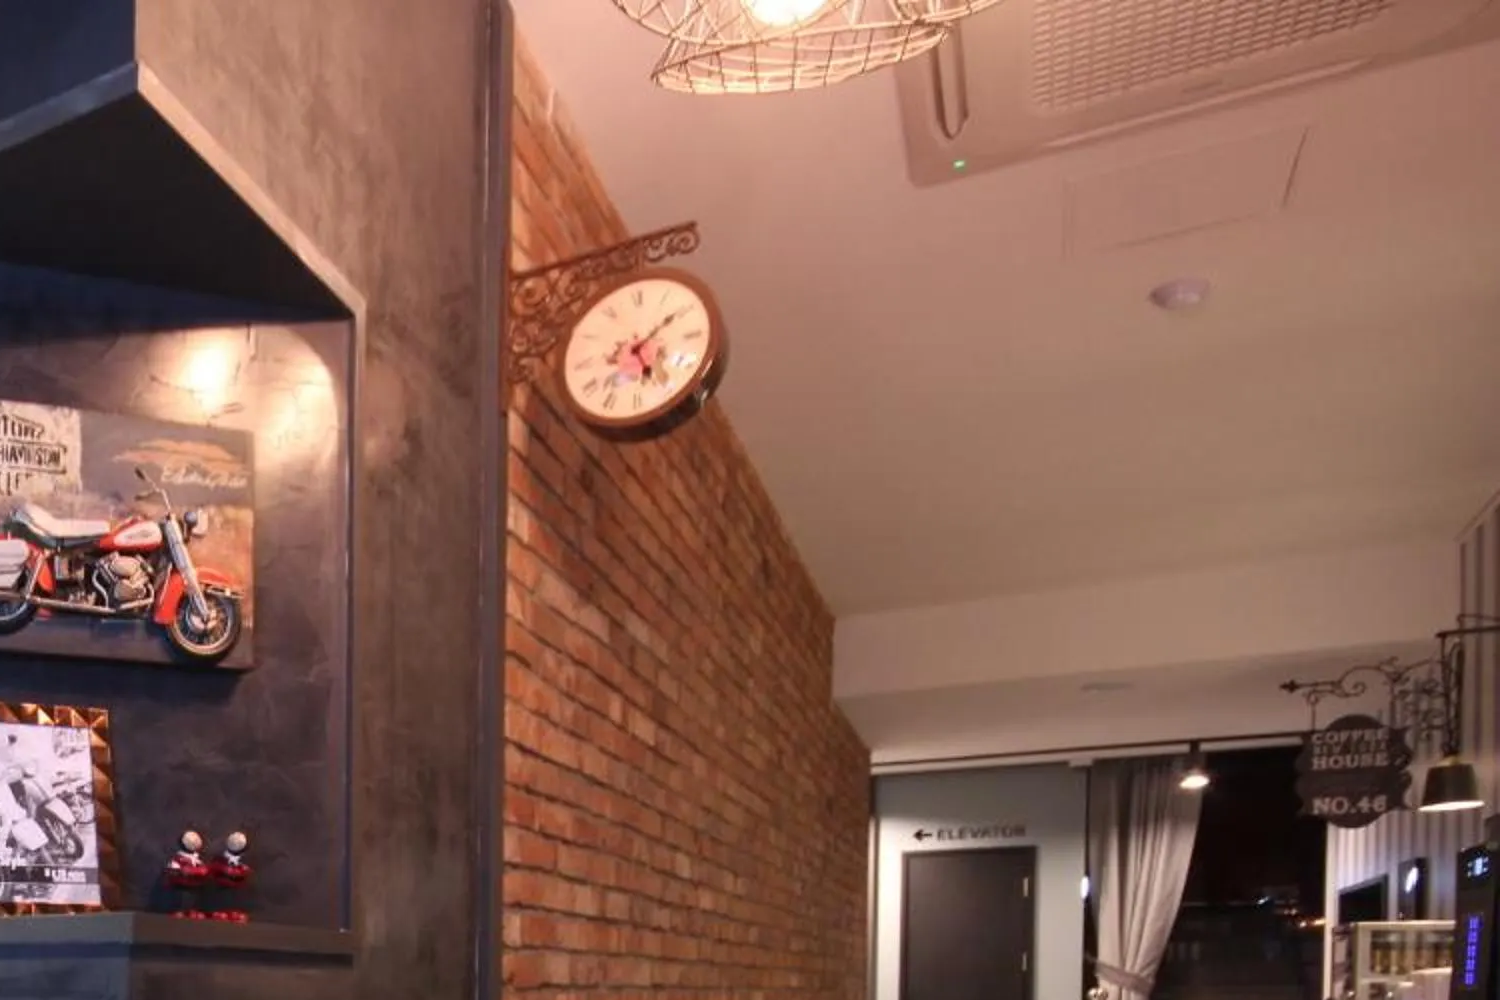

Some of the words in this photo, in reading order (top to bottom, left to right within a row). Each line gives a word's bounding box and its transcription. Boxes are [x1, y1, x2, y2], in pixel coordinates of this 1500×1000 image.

[1312, 727, 1389, 744] COFFEE
[1313, 753, 1388, 769] HOUSE
[935, 825, 1026, 841] ELEVATOR
